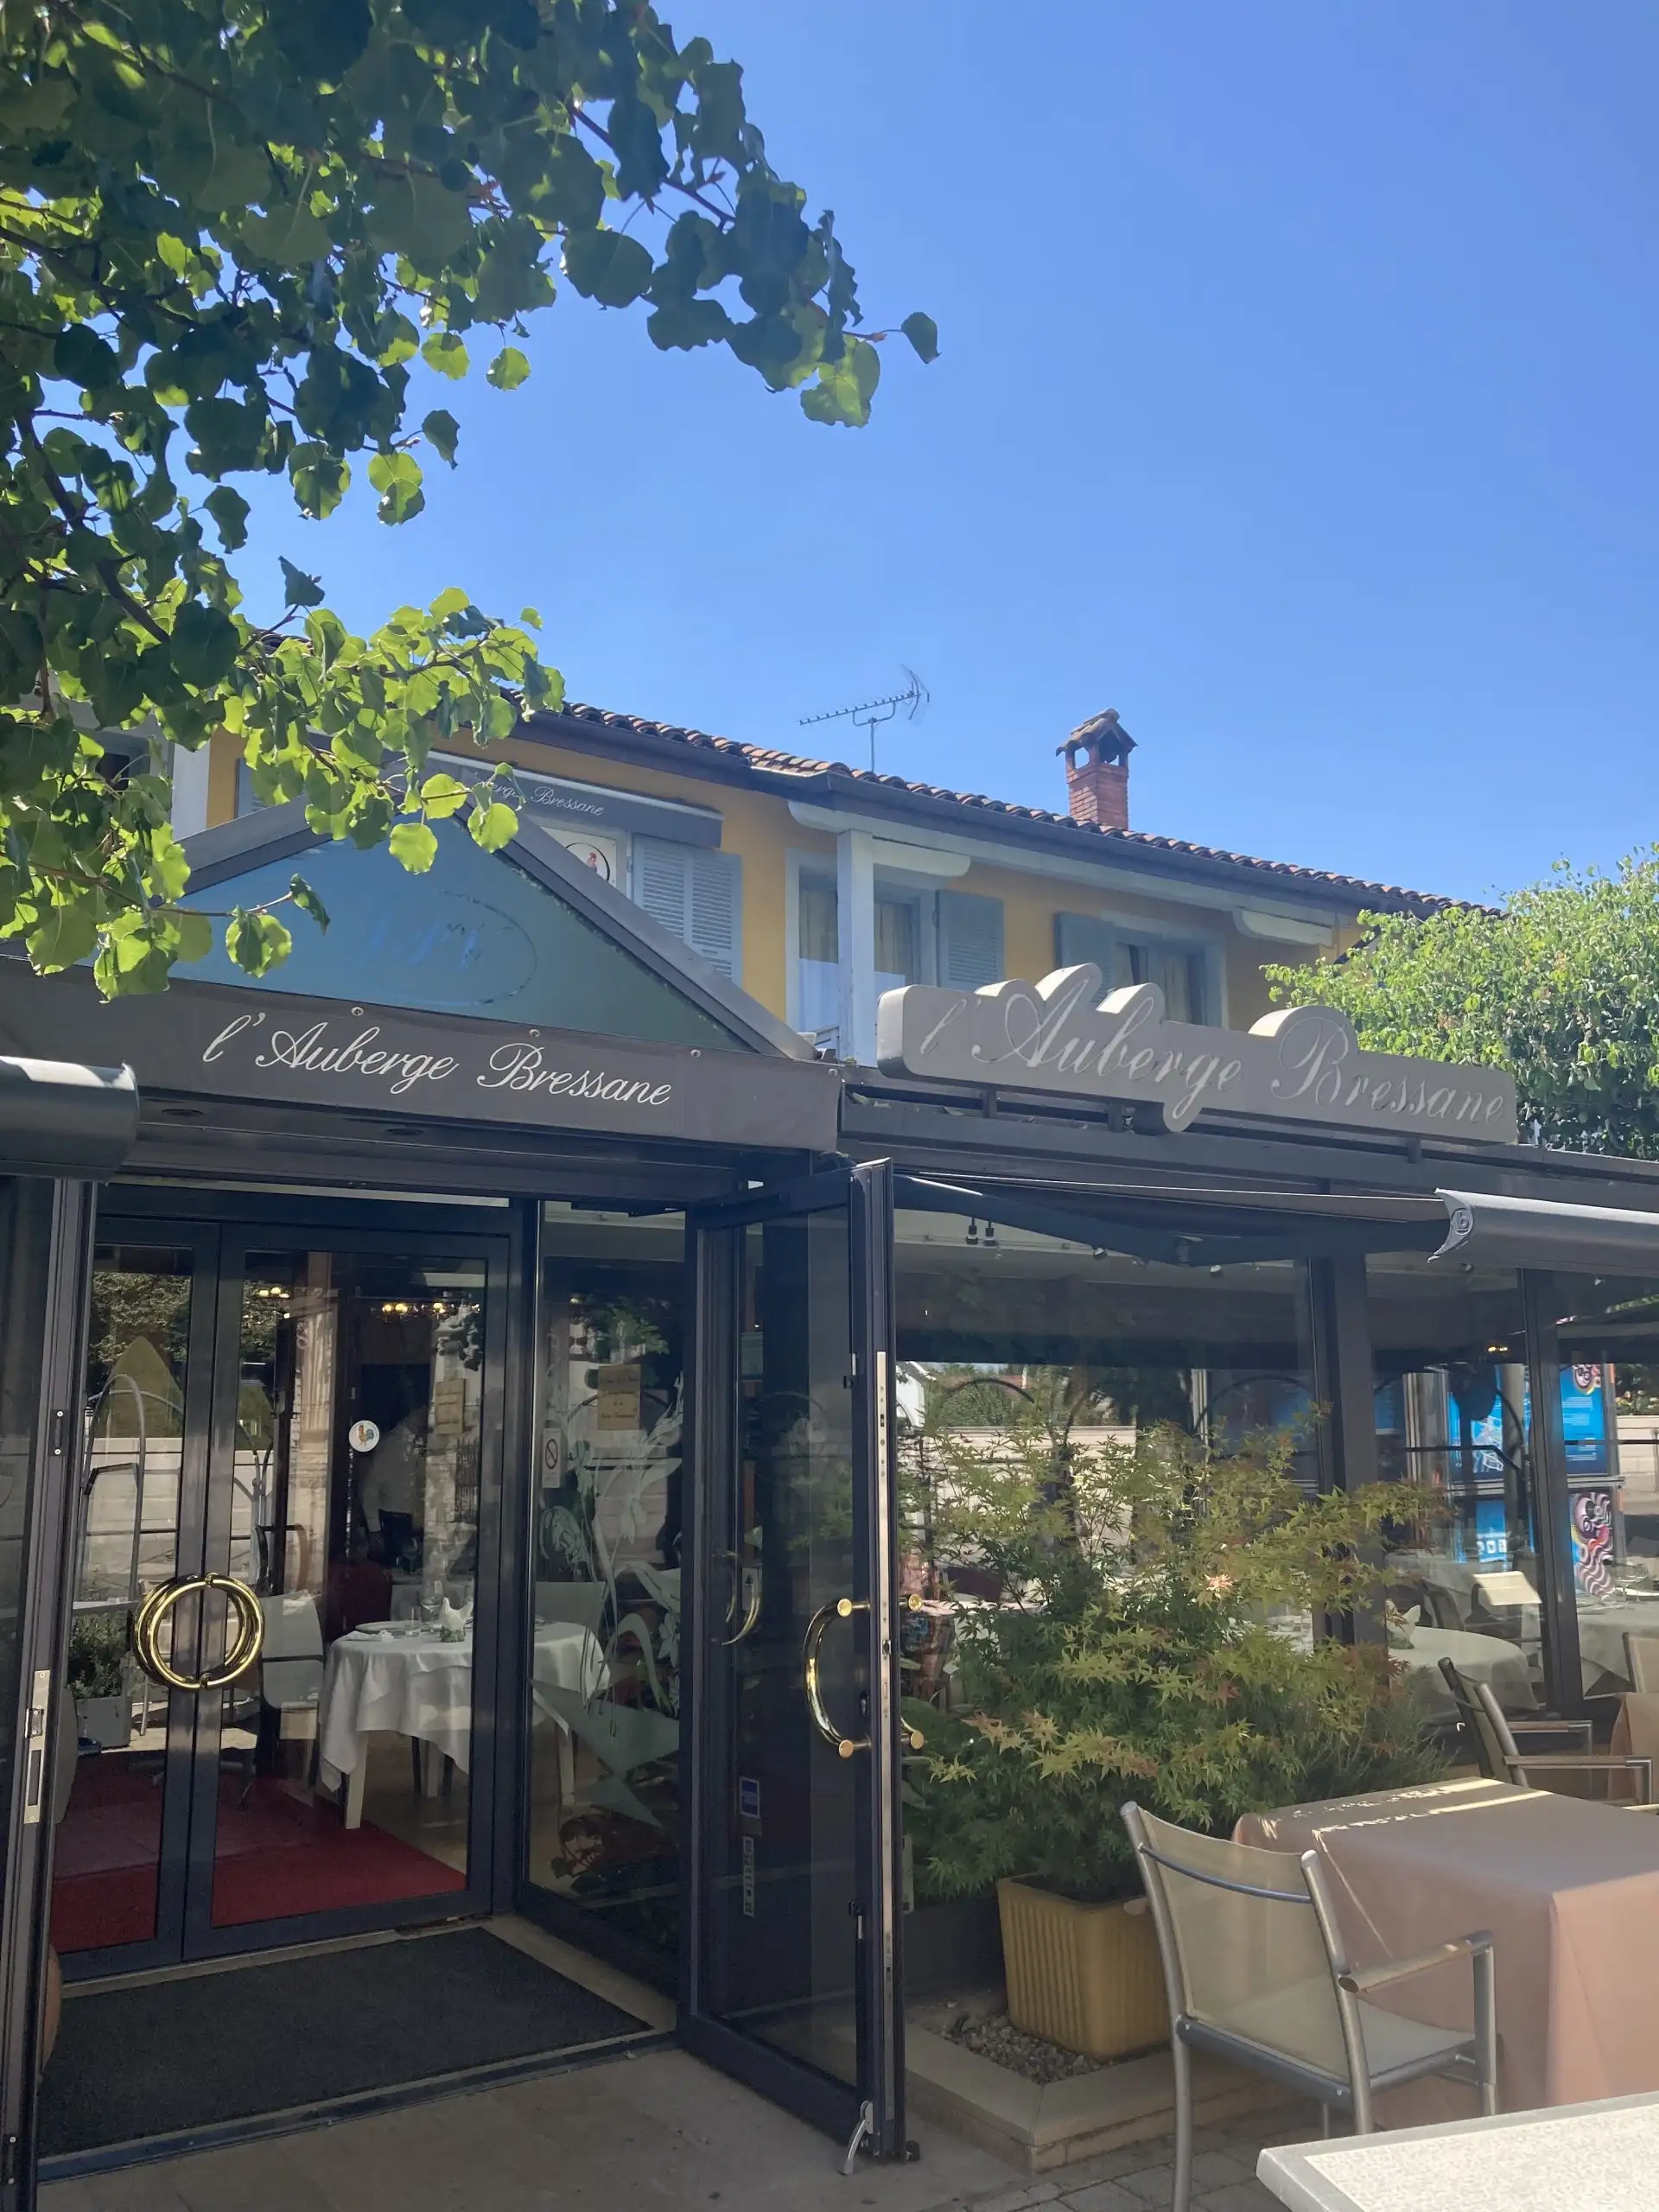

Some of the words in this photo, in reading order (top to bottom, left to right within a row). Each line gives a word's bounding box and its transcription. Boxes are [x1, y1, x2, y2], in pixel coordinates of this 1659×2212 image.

[530, 785, 605, 816] Bressane
[476, 1042, 673, 1106] Bressane
[1271, 1015, 1504, 1124] Bressane
